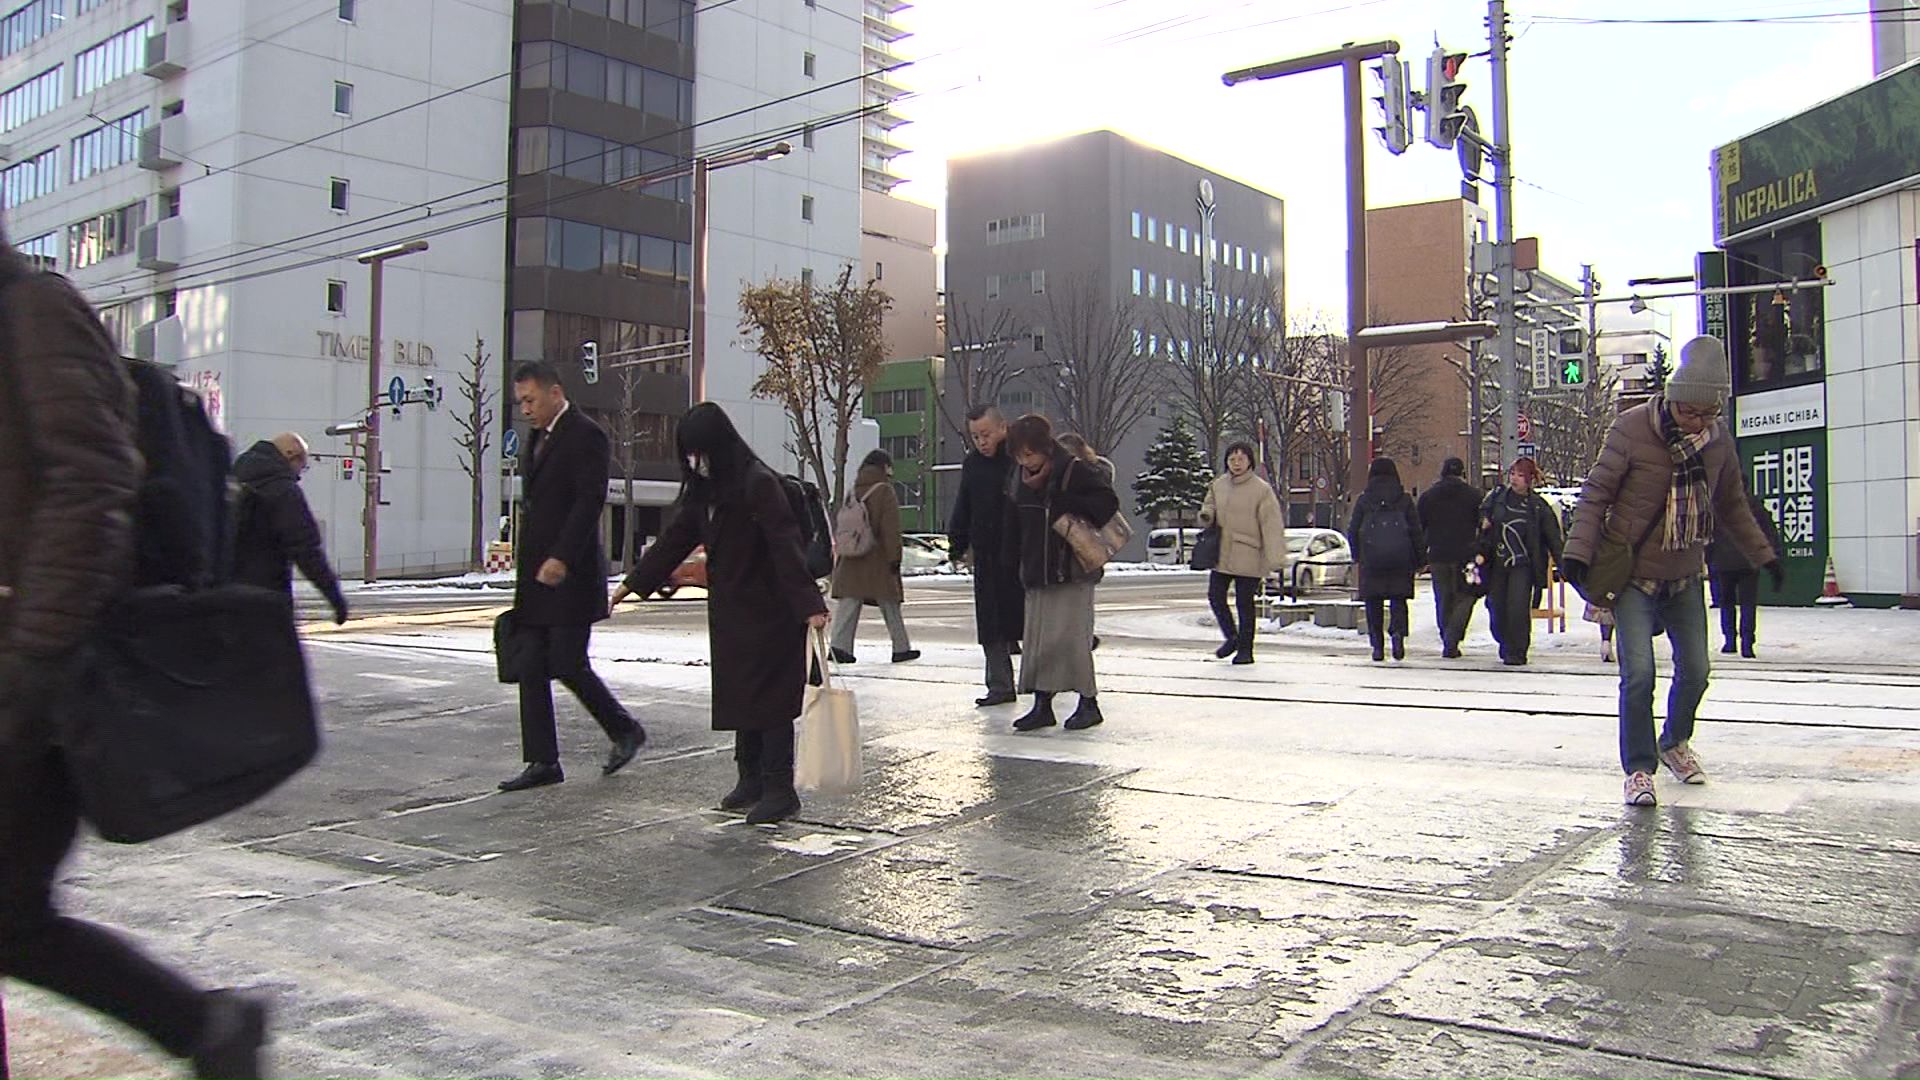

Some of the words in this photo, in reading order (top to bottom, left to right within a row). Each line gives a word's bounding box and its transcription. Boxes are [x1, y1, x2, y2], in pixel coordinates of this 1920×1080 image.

[1735, 169, 1817, 224] NEPALICA
[317, 330, 383, 361] TIME
[1741, 413, 1781, 429] MEGANE
[1784, 408, 1819, 423] ICHIBA
[1783, 445, 1813, 543] 眼鏡
[1788, 547, 1814, 558] ICHIBA
